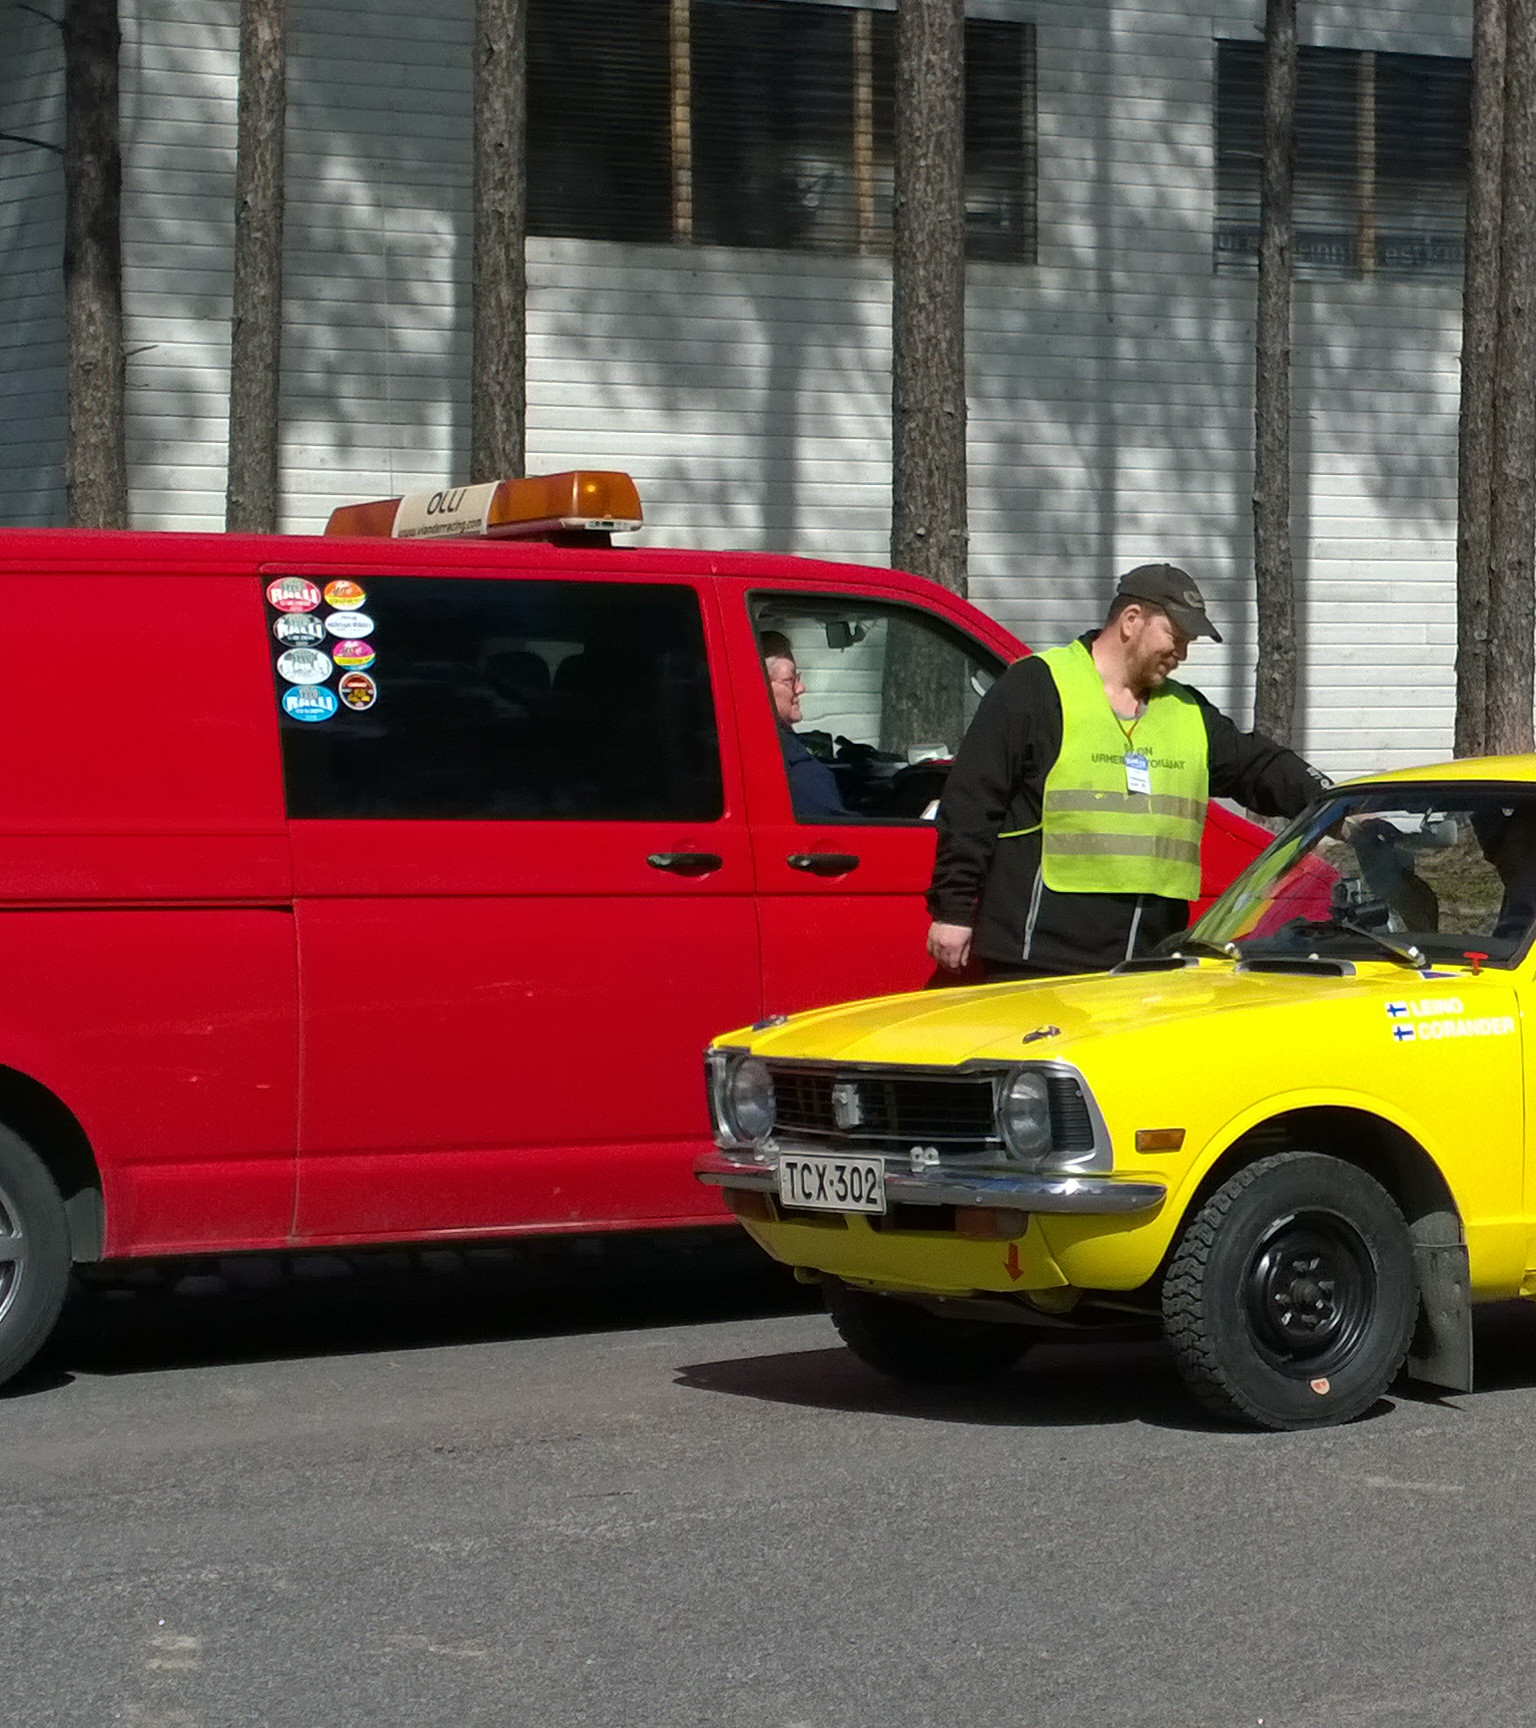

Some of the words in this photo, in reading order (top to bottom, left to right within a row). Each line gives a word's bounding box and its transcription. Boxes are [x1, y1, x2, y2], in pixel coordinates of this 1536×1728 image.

[426, 488, 468, 516] OLLI
[1409, 998, 1463, 1016] LEINO
[1418, 1017, 1514, 1039] CORANDER
